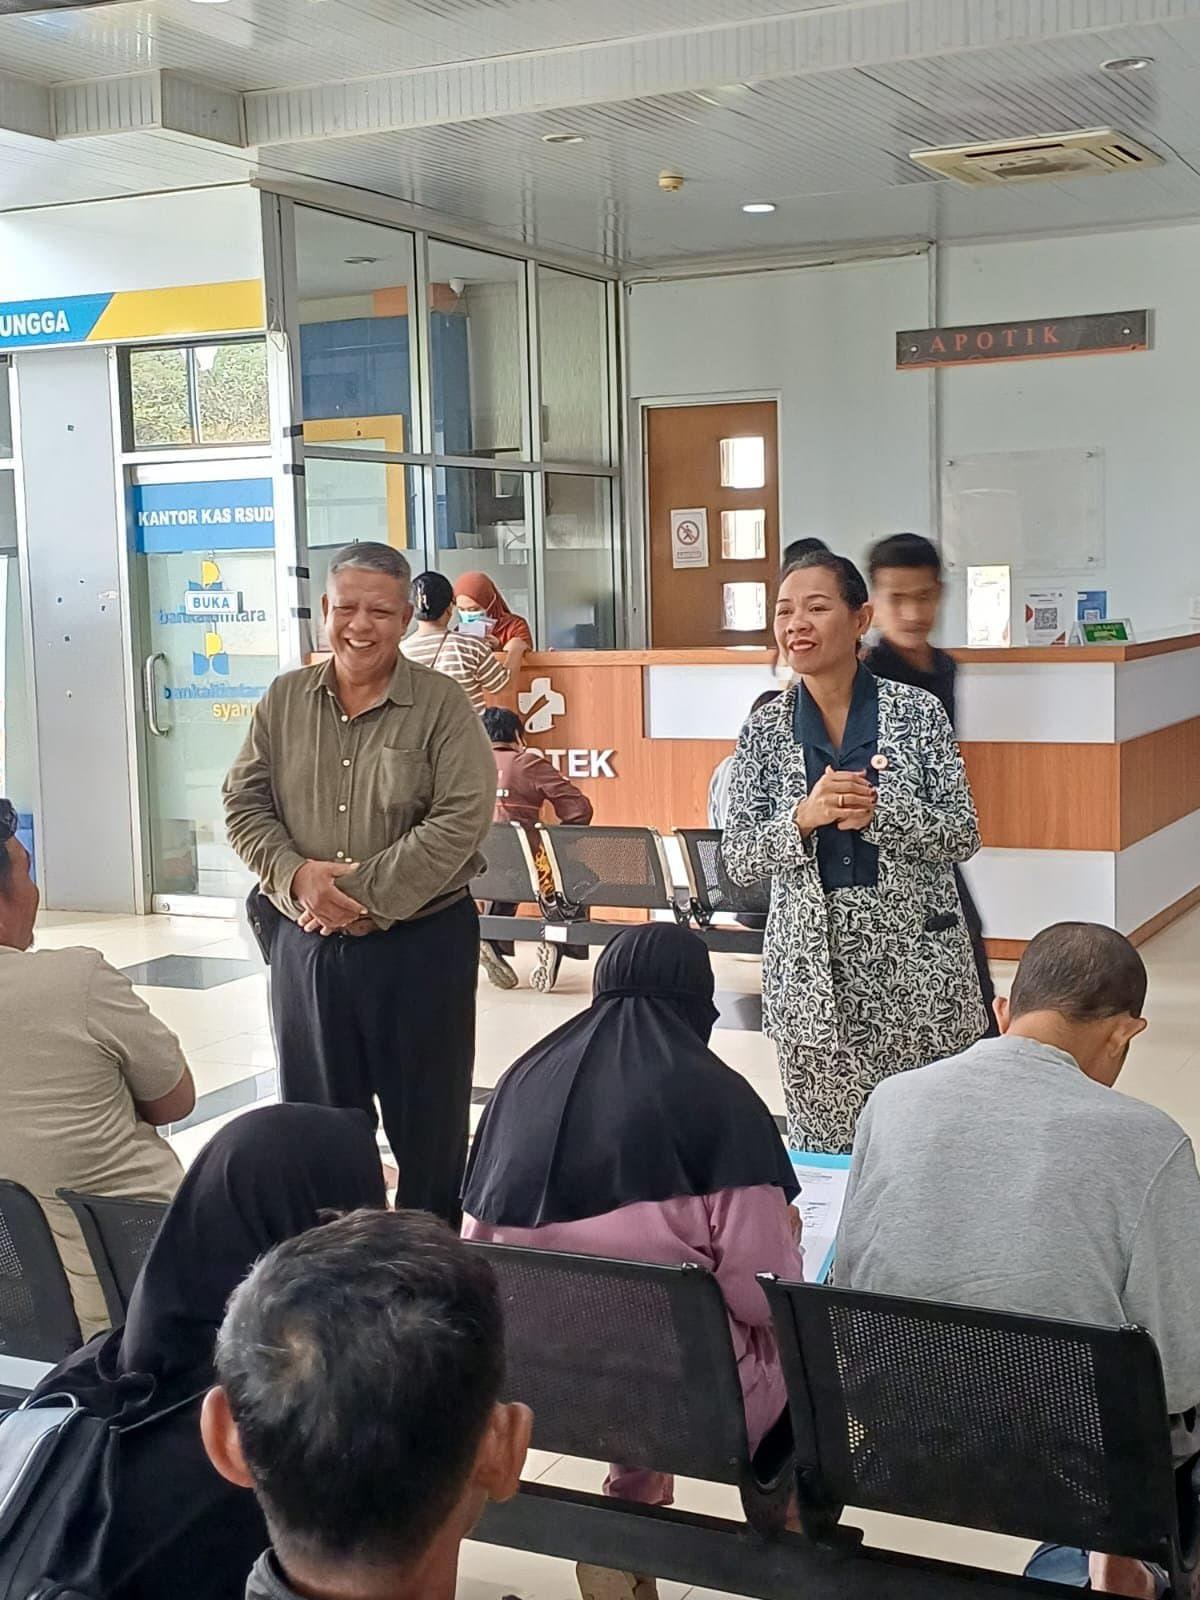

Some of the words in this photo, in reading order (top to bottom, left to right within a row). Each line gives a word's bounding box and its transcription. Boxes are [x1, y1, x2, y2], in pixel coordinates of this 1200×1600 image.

[0, 310, 71, 337] UNGGA
[930, 326, 1061, 353] APOTIK
[138, 509, 198, 527] KANTOR
[201, 507, 231, 525] KAS
[234, 505, 274, 523] RSUD
[193, 597, 231, 609] BUKA
